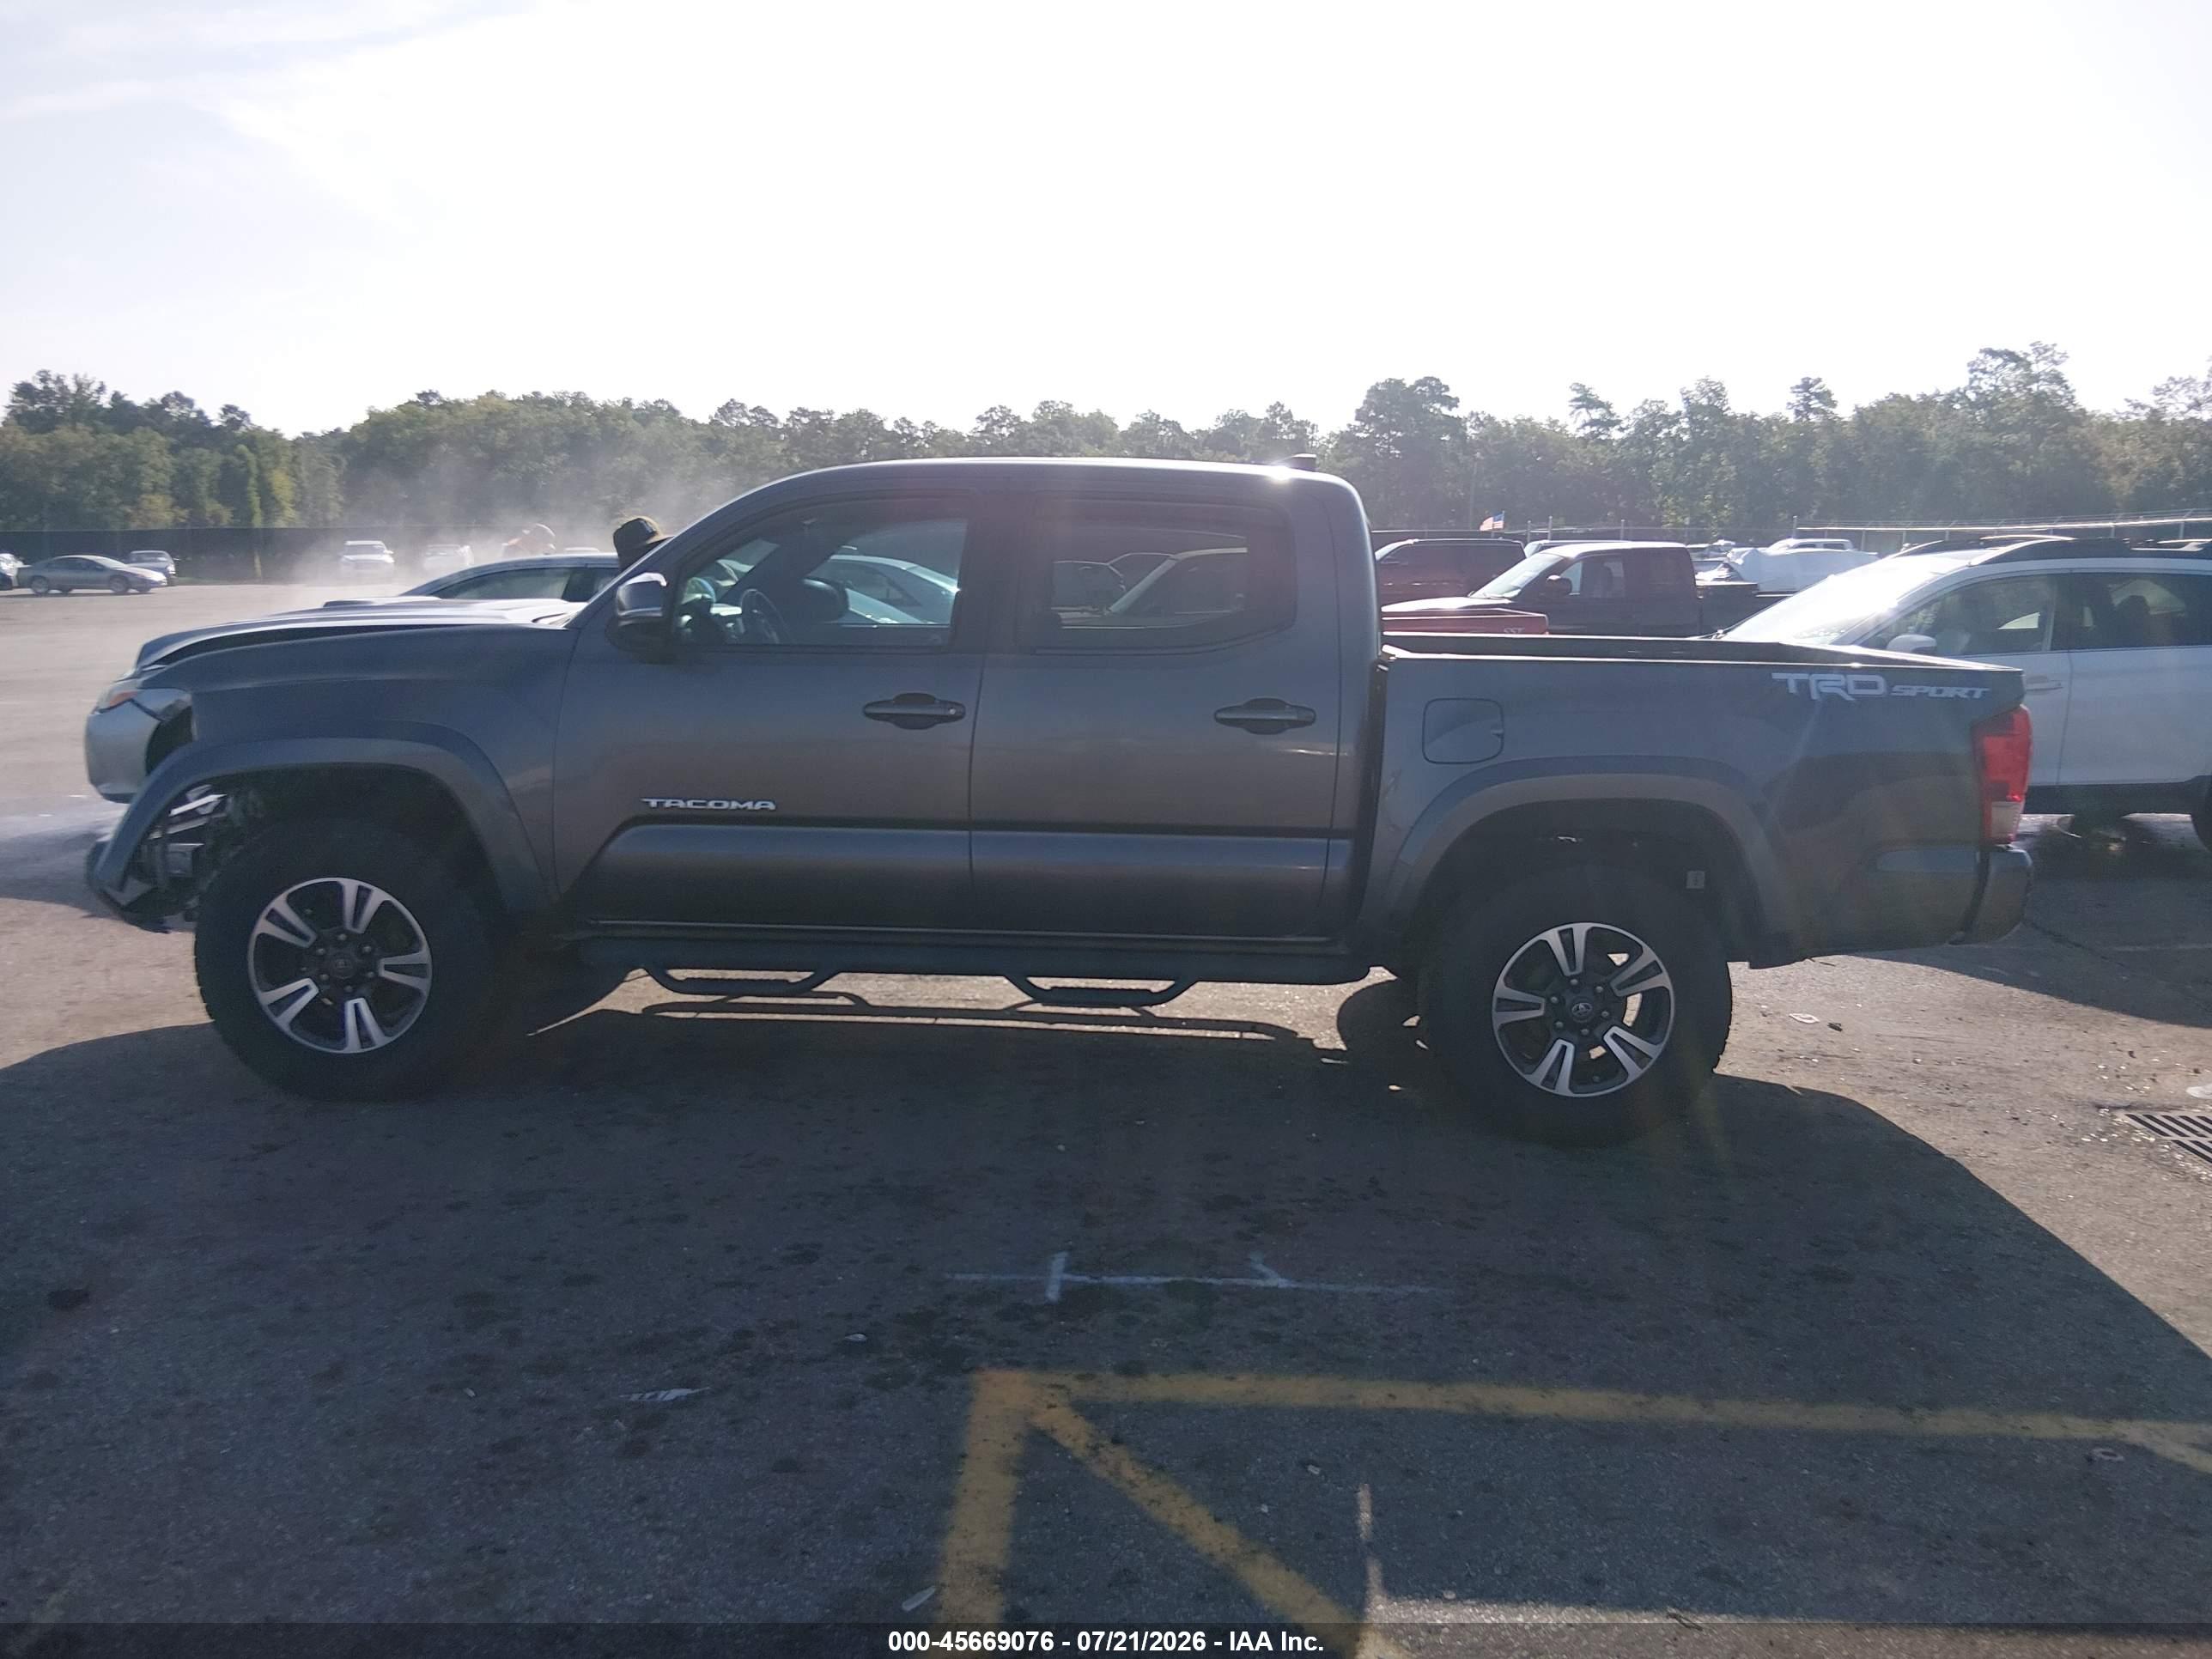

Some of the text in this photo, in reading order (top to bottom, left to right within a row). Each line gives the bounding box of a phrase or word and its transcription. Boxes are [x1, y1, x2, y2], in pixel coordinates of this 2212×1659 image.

[1771, 672, 1990, 701] TRD SPORT
[641, 797, 776, 811] TACOMA
